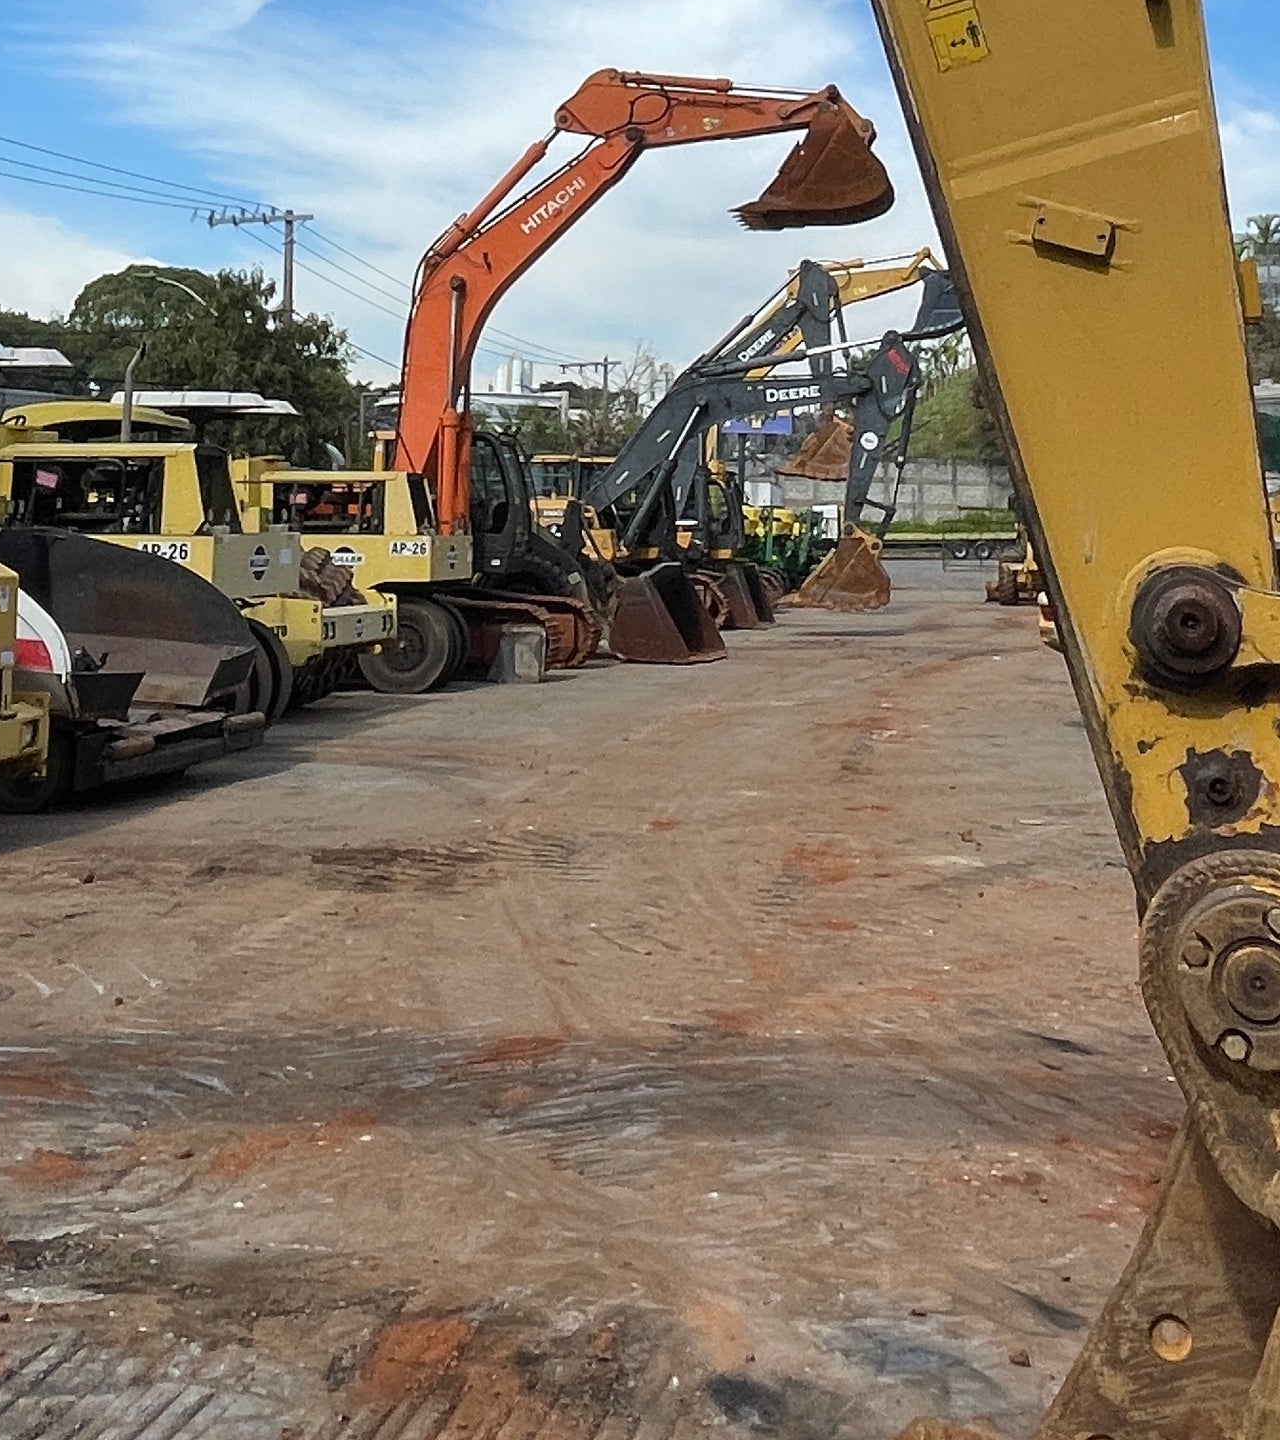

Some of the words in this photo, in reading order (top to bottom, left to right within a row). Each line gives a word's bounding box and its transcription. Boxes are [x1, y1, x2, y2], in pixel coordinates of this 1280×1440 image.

[520, 176, 586, 235] HITACHI
[737, 329, 776, 362] DEERE
[765, 385, 821, 402] DEERE
[391, 542, 427, 555] AP-26
